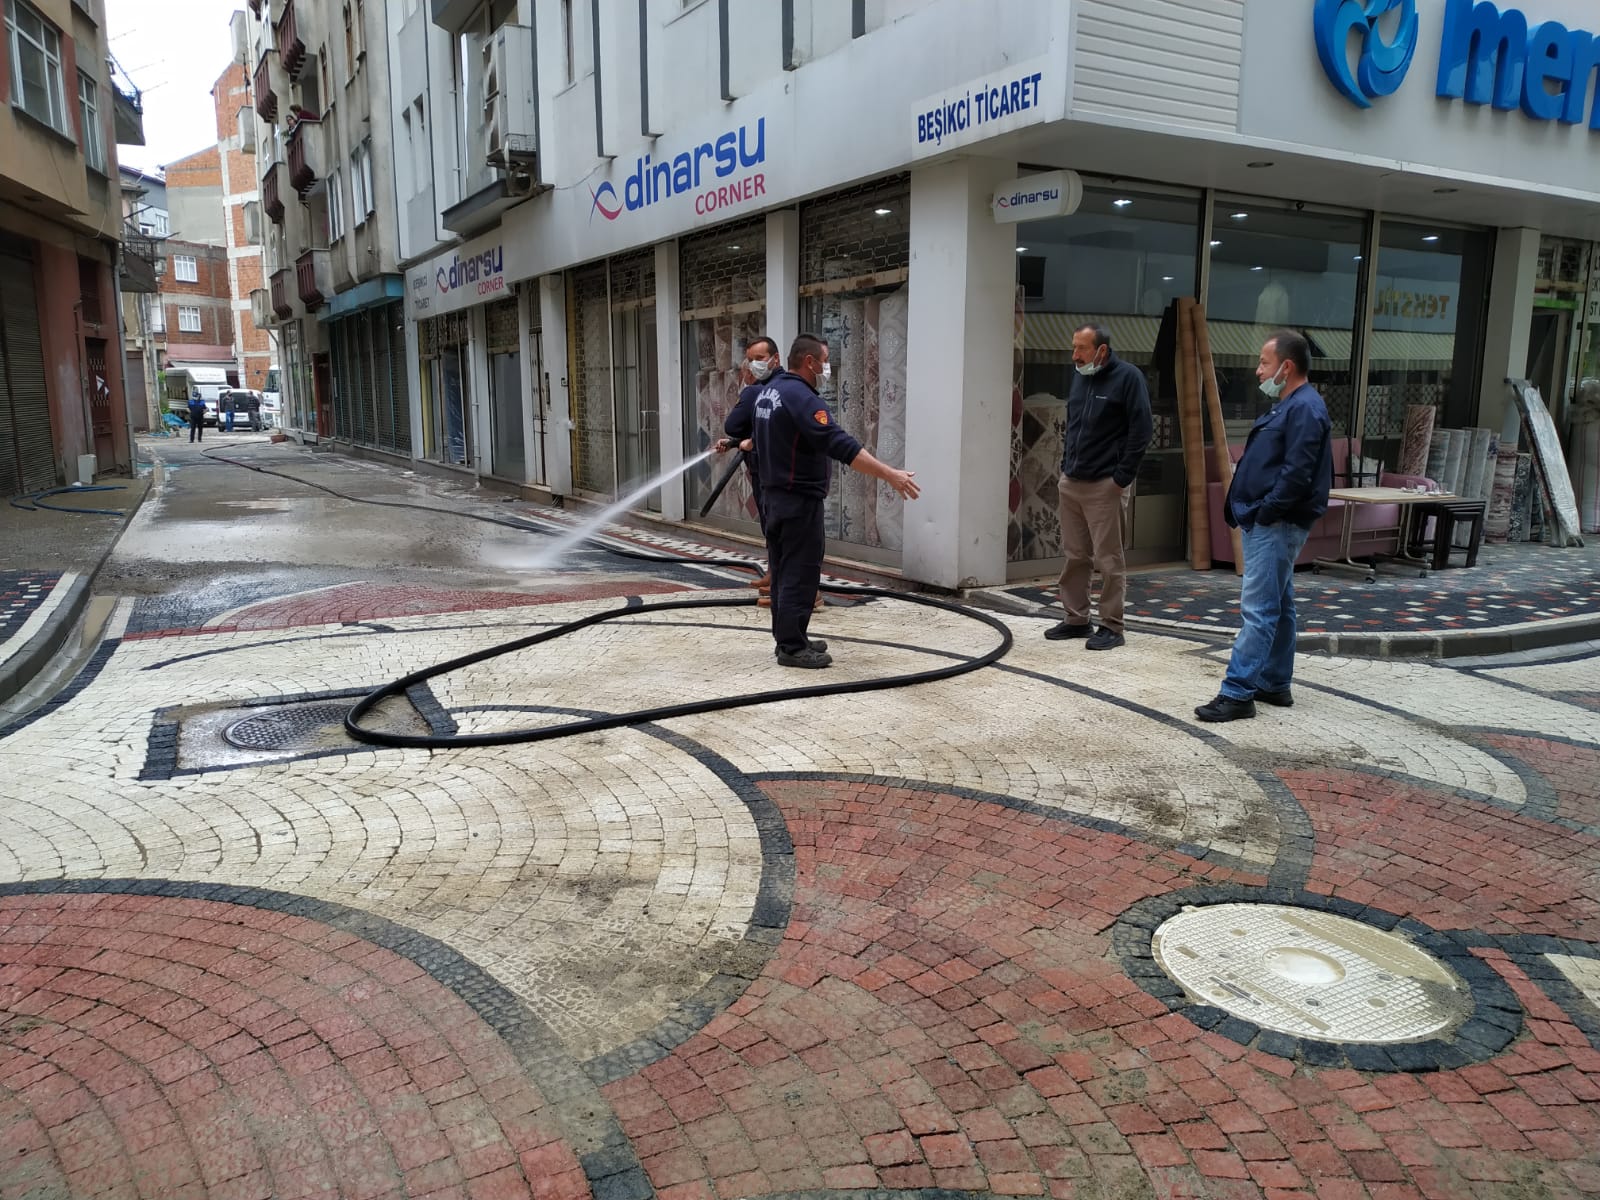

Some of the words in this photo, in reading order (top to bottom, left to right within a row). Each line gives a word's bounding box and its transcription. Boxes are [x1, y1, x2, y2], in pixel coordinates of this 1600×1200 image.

[918, 90, 970, 145] BEŞİKCİ
[975, 72, 1042, 125] TİCARET
[624, 116, 765, 212] dinarsu
[695, 173, 766, 215] CORNER
[1010, 188, 1058, 206] dinarsu
[449, 245, 503, 289] dinarsu
[478, 276, 504, 295] CORNER
